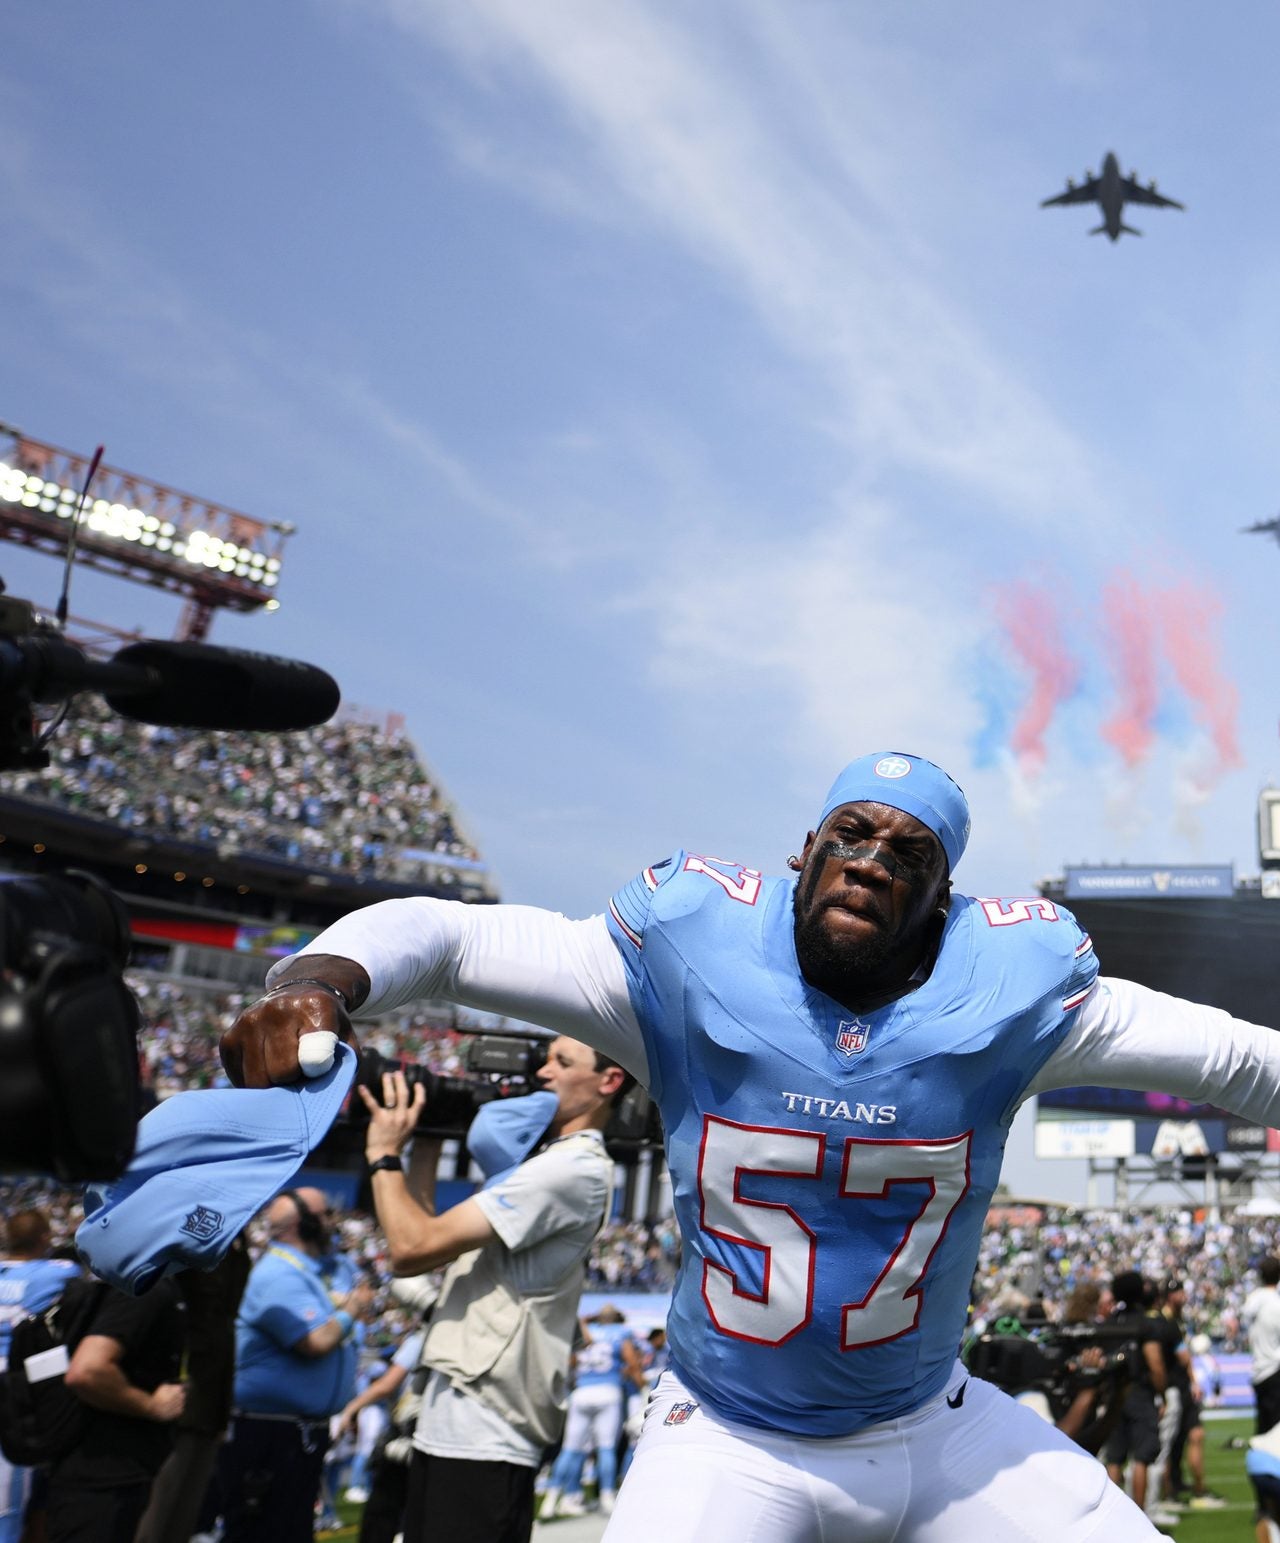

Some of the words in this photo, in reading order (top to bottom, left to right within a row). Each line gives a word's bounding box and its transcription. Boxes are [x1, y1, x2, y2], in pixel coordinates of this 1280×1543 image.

[840, 1033, 861, 1049] NFL
[781, 1091, 897, 1125] TITANS
[697, 1112, 974, 1351] 57
